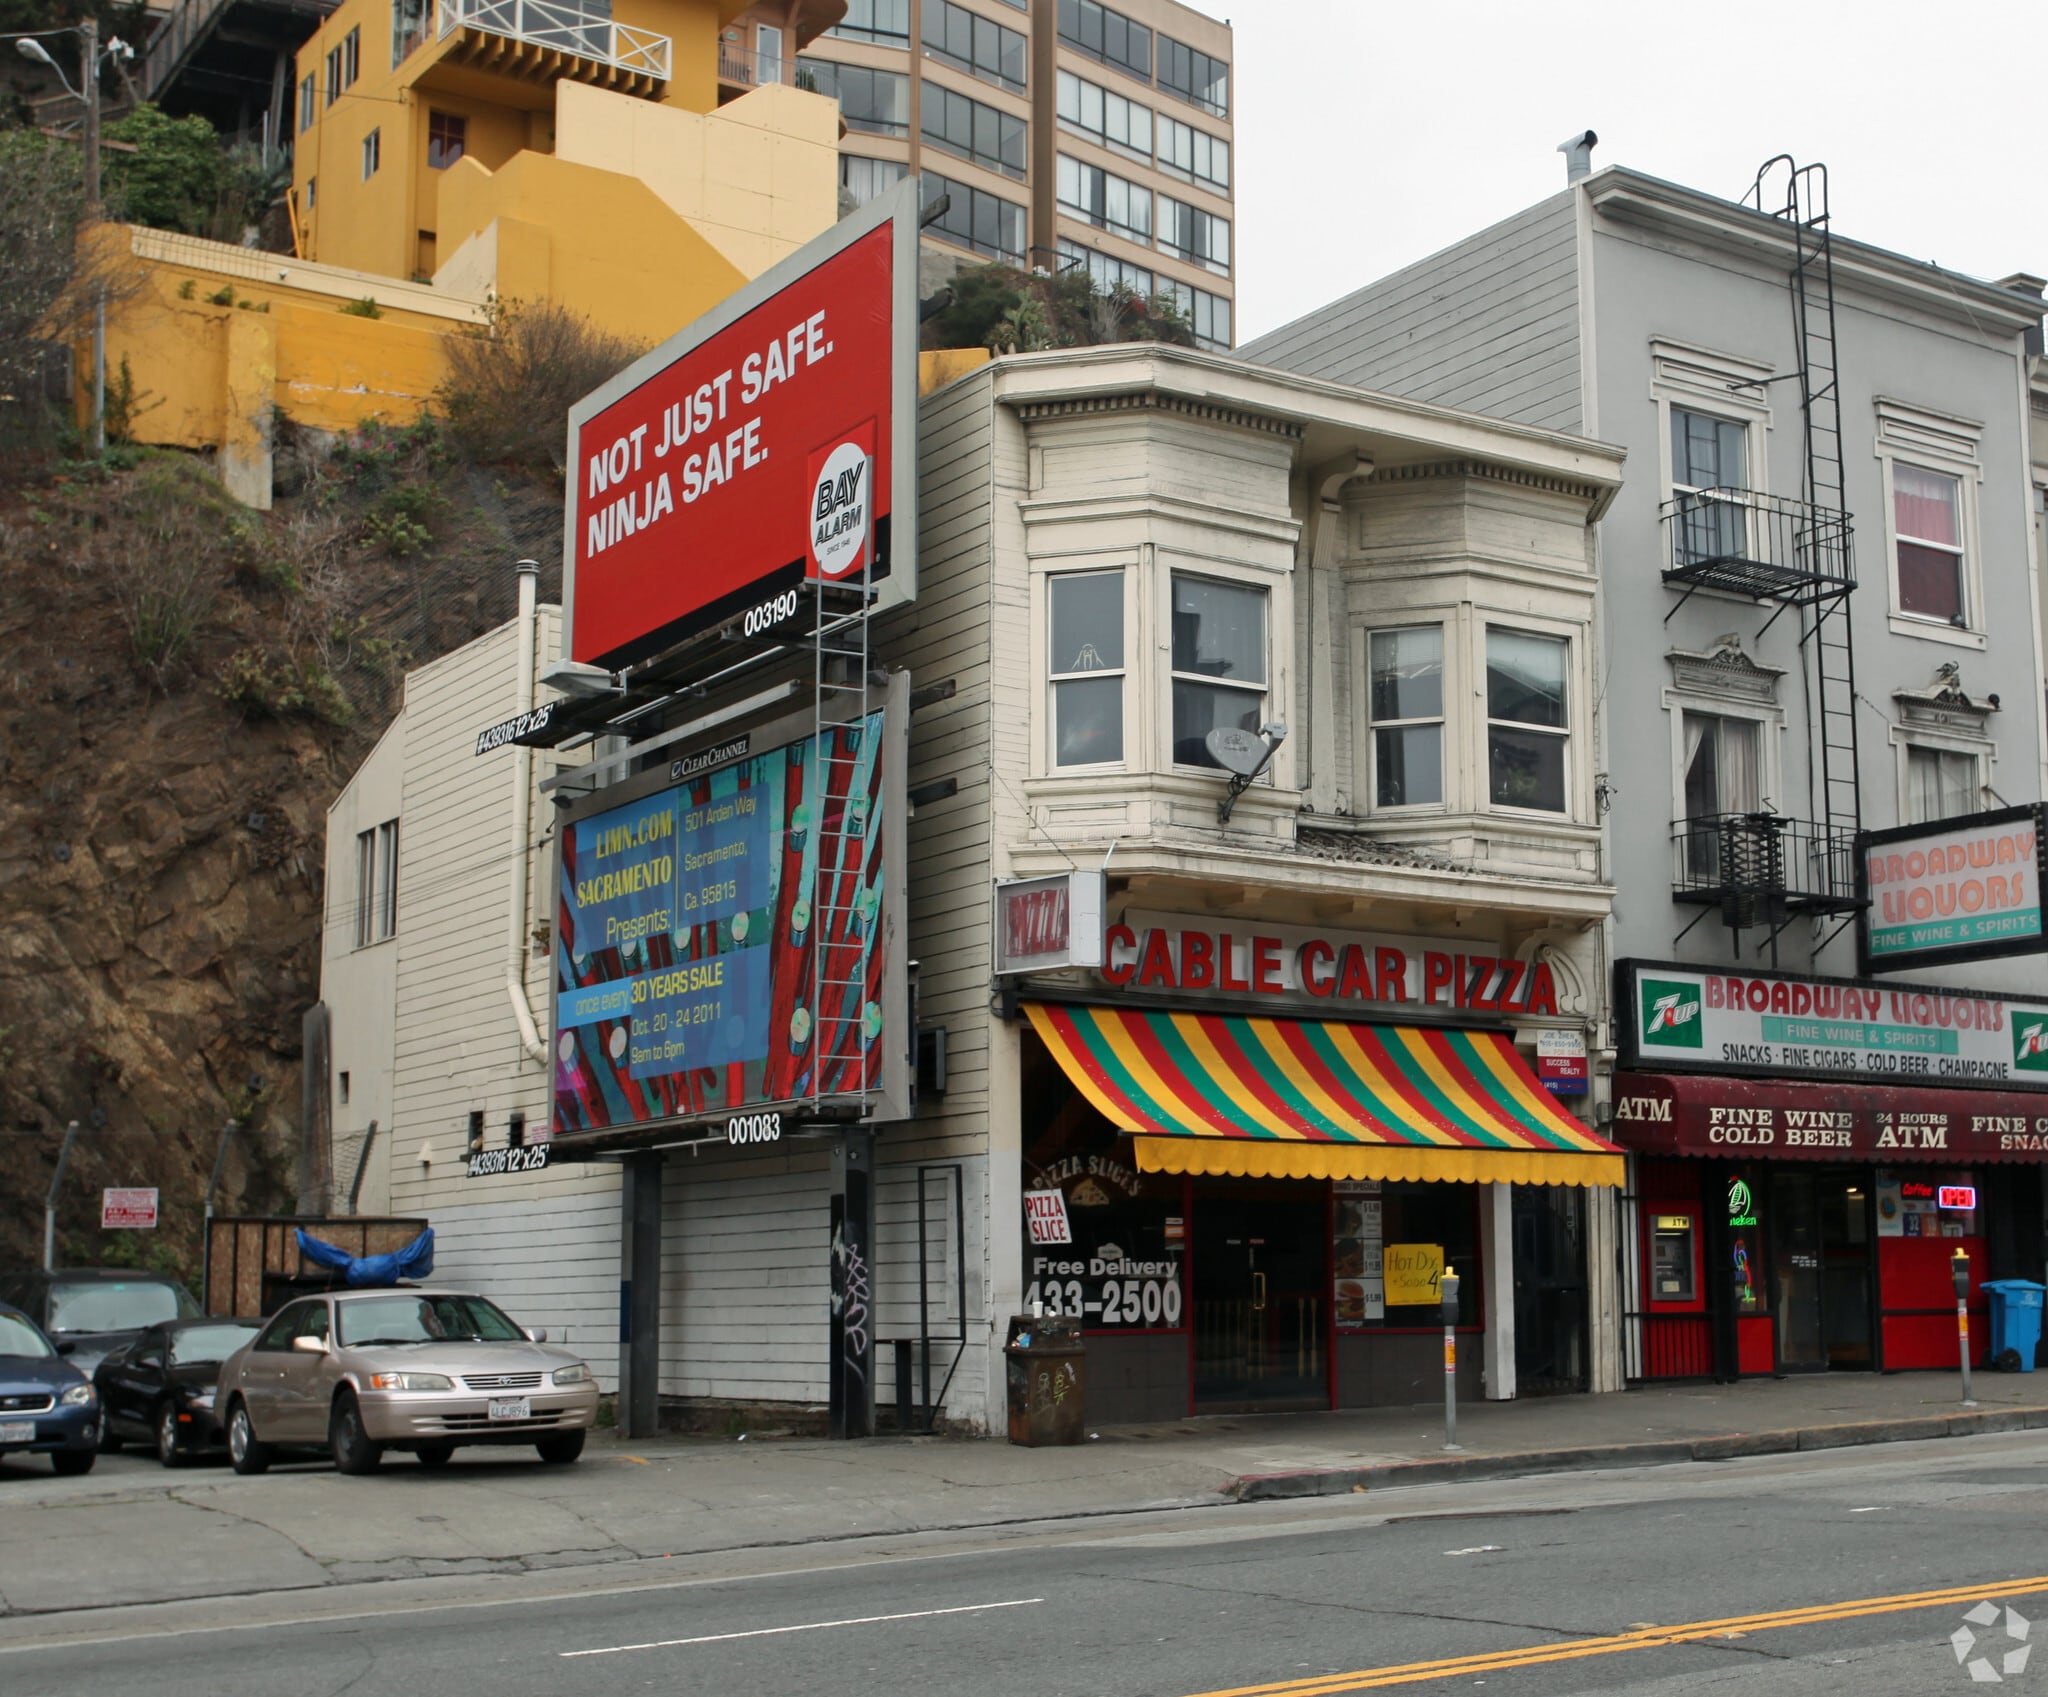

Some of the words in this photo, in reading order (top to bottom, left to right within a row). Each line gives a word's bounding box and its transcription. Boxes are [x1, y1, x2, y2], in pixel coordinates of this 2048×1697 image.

[588, 422, 647, 499] NOT
[654, 369, 732, 458] JUST
[741, 309, 834, 405] SAFE.
[587, 472, 674, 558] NINJA
[682, 416, 769, 504] SAFE.
[816, 460, 865, 522] BAY
[815, 504, 862, 547] ALARM
[744, 590, 797, 637] 003190
[685, 813, 703, 832] 501
[706, 804, 733, 825] Arden
[735, 795, 757, 816] Way
[596, 808, 672, 859] LIMN.COM
[685, 841, 747, 871] Sacramento,
[1869, 832, 2036, 886] BROADWAY
[577, 855, 672, 908] SACRAMENTO
[684, 892, 699, 910] Ca.
[702, 880, 736, 906] 95815
[1883, 872, 2024, 923] LIQUORS
[606, 908, 671, 944] Presents:
[1872, 932, 1906, 947] FINE
[1912, 926, 1953, 942] WINE
[1959, 923, 1970, 936] &
[1977, 914, 2039, 934] SPIRITS
[1101, 924, 1284, 995] CABLE
[1299, 939, 1407, 1003] CAR
[1425, 951, 1558, 1016] PIZZA
[576, 997, 599, 1016] once
[601, 990, 630, 1012] every
[631, 980, 647, 1004] 30
[649, 970, 688, 999] YEARS
[690, 962, 723, 991] SALE
[1705, 975, 1881, 1021] BROADWAY
[1891, 991, 2004, 1032] LIQUORS
[631, 1018, 650, 1036] Oct.
[653, 1014, 668, 1032] 20
[676, 1009, 690, 1027] 24
[693, 1002, 721, 1024] 2011
[1647, 992, 1699, 1034] 7UP
[631, 1047, 651, 1064] 9am
[653, 1046, 662, 1060] to
[664, 1040, 685, 1062] 6pm
[1787, 1024, 1820, 1039] FINE
[1824, 1027, 1864, 1042] WINE
[1869, 1030, 1879, 1043] &
[1884, 1031, 1936, 1047] SPIRITS
[1560, 1067, 1580, 1075] REALTY
[1722, 1043, 1772, 1064] SNACKS
[1783, 1048, 1810, 1066] FINE
[1813, 1050, 1856, 1070] CIGARS
[1867, 1053, 1896, 1071] COLD
[1901, 1055, 1929, 1073] BEER
[1939, 1058, 2008, 1079] CHAMPAGNE
[1615, 1097, 1673, 1122] ATM
[1709, 1107, 1773, 1126] FINE
[1784, 1110, 1853, 1128] WINE
[1876, 1113, 1893, 1123] 24
[1900, 1114, 1948, 1124] HOURS
[1971, 1116, 2026, 1132] FINE
[728, 1112, 780, 1145] 001083
[1709, 1126, 1774, 1144] COLD
[1785, 1129, 1852, 1147] BEER
[1876, 1125, 1948, 1148] ATM
[1032, 1155, 1084, 1188] PIZZA
[1088, 1155, 1141, 1197] SLICES
[1902, 1183, 1933, 1196] Coffee
[1024, 1196, 1064, 1218] PIZZA
[1942, 1188, 1972, 1206] OPEN
[1032, 1219, 1067, 1242] SLICE
[1033, 1257, 1085, 1275] Free
[1090, 1257, 1178, 1278] Delivery
[1023, 1280, 1182, 1323] 433-2500
